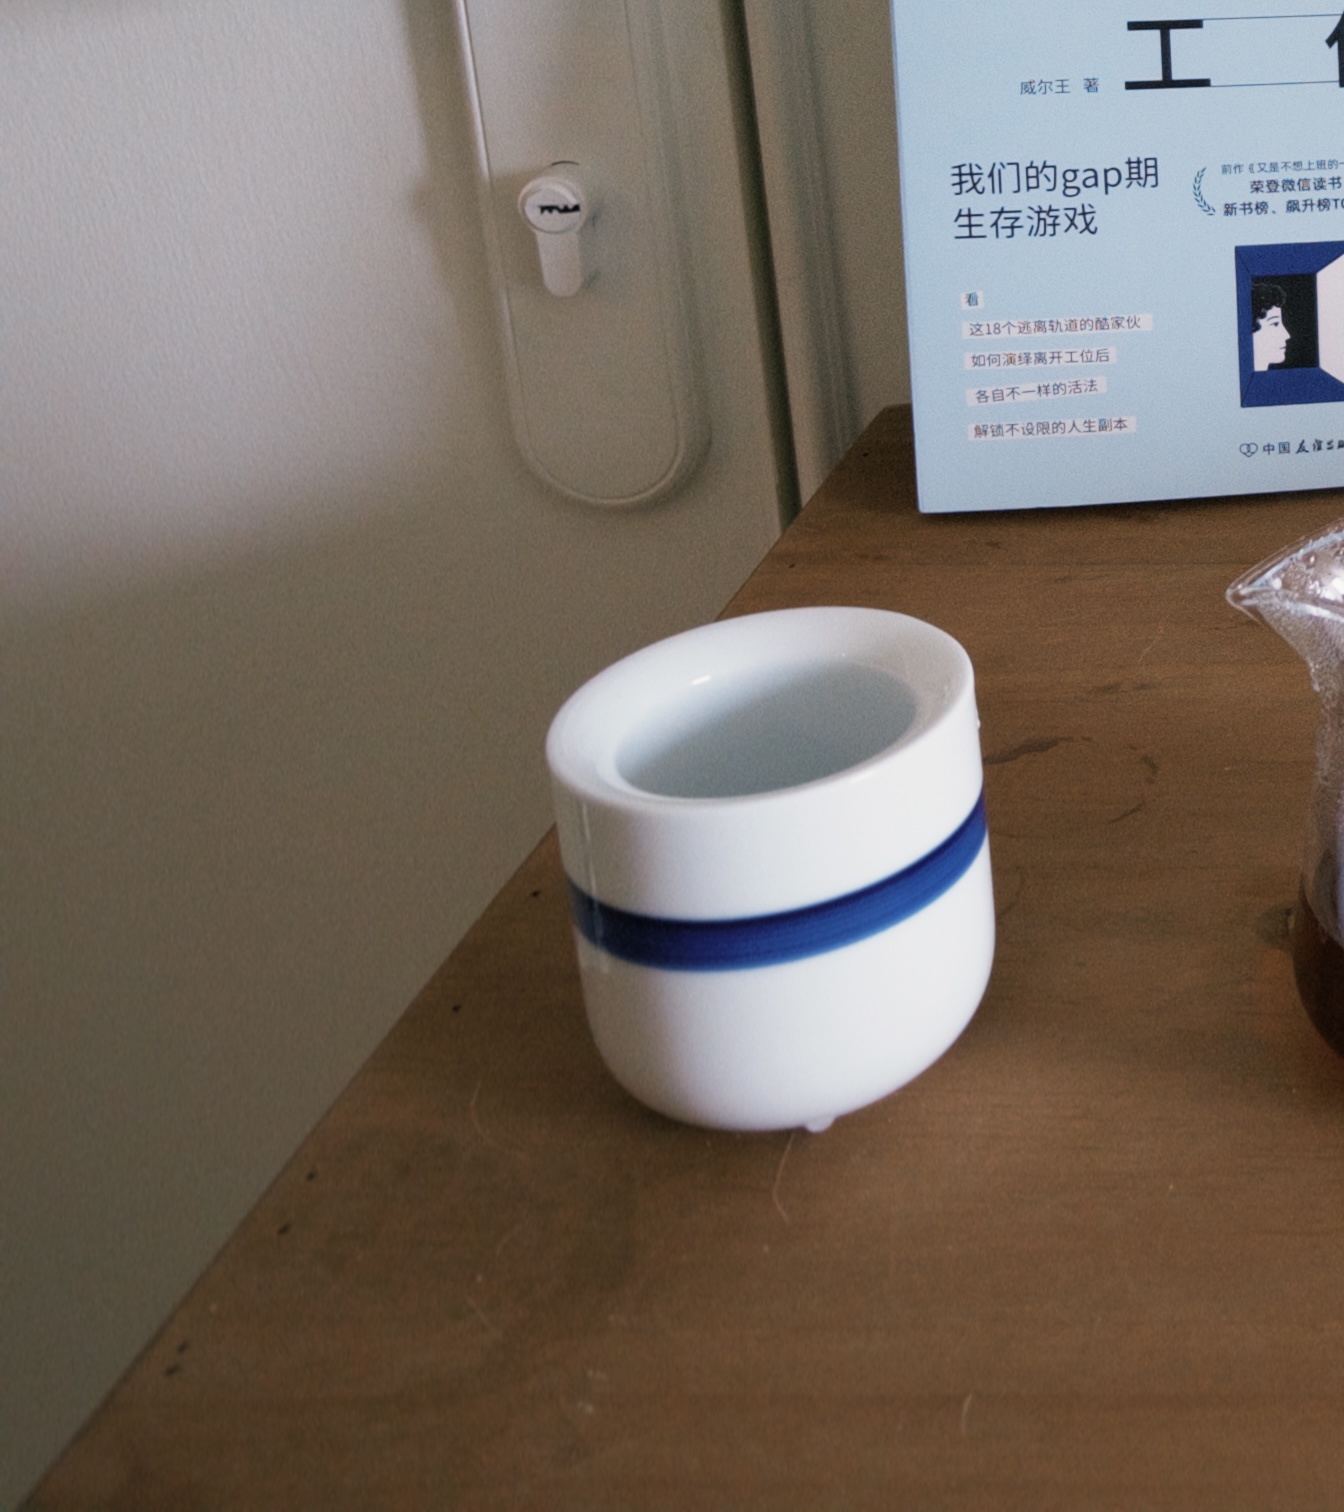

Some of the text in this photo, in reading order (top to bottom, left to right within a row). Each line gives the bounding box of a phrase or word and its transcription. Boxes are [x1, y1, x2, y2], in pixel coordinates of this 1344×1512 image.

[1020, 77, 1099, 95] 威尔王 著
[950, 156, 1159, 197] 我们的gap期
[1250, 175, 1342, 194] 荣登微信读书
[953, 202, 1098, 239] 生存游戏
[969, 315, 1142, 336] 这18个逃离轨道的酷家伙
[971, 348, 1110, 368] 如何演绎离开工位后
[975, 378, 1098, 404] 各自不一样的活法
[974, 417, 1128, 438] 解锁不设限的人生副本
